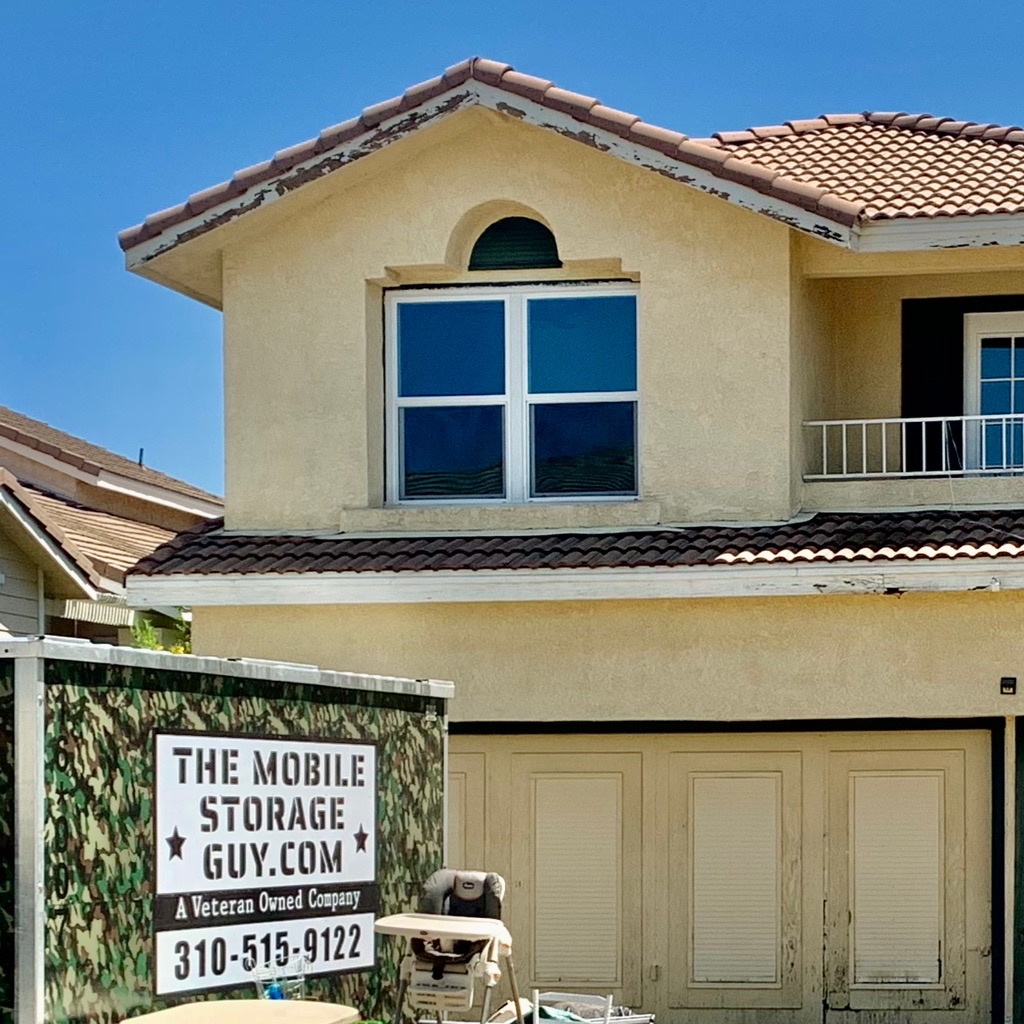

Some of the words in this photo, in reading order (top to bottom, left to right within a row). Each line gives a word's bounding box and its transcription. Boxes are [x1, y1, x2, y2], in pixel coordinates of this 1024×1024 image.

[172, 746, 239, 785] THE
[253, 750, 365, 787] MOBILE
[200, 795, 345, 833] STORAGE
[203, 840, 343, 880] GUY.COM
[175, 896, 188, 920] A
[192, 895, 254, 918] Veteran
[259, 892, 303, 912] Owned
[308, 888, 362, 912] Company
[174, 923, 361, 980] 310-515-9122
